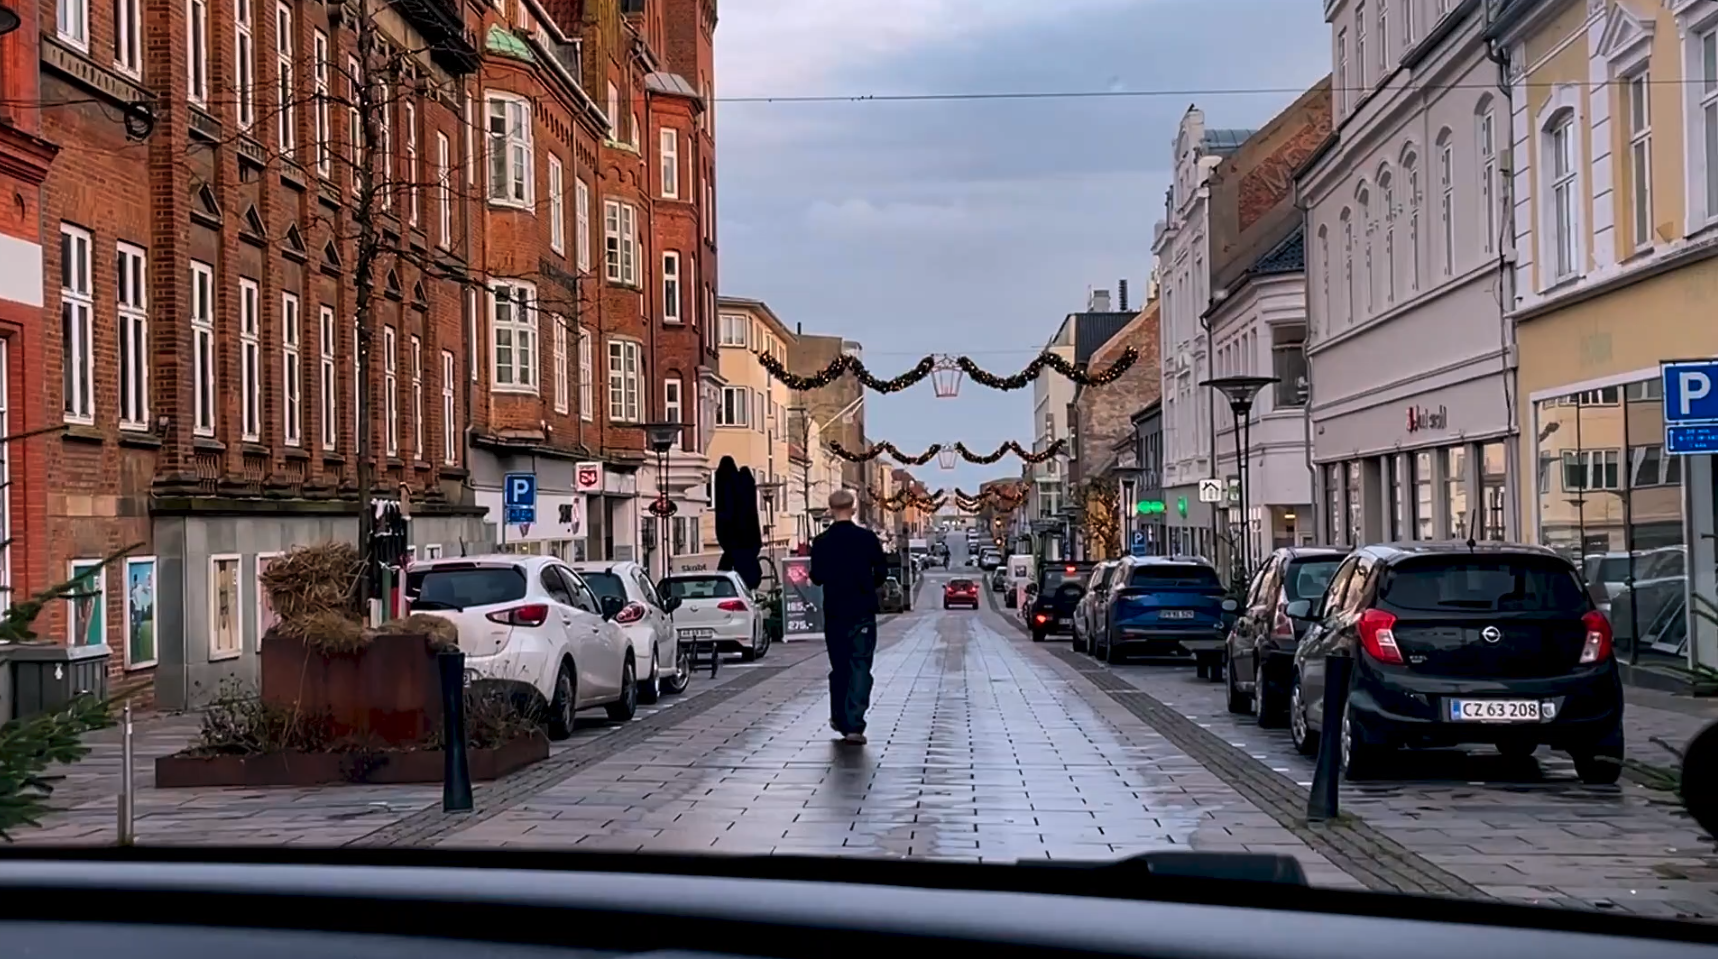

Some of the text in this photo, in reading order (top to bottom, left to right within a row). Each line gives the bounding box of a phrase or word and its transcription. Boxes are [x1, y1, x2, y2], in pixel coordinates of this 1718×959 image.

[1679, 371, 1711, 415] P
[513, 479, 529, 502] P
[1135, 532, 1143, 544] P
[1463, 702, 1537, 717] CZ 63 208
